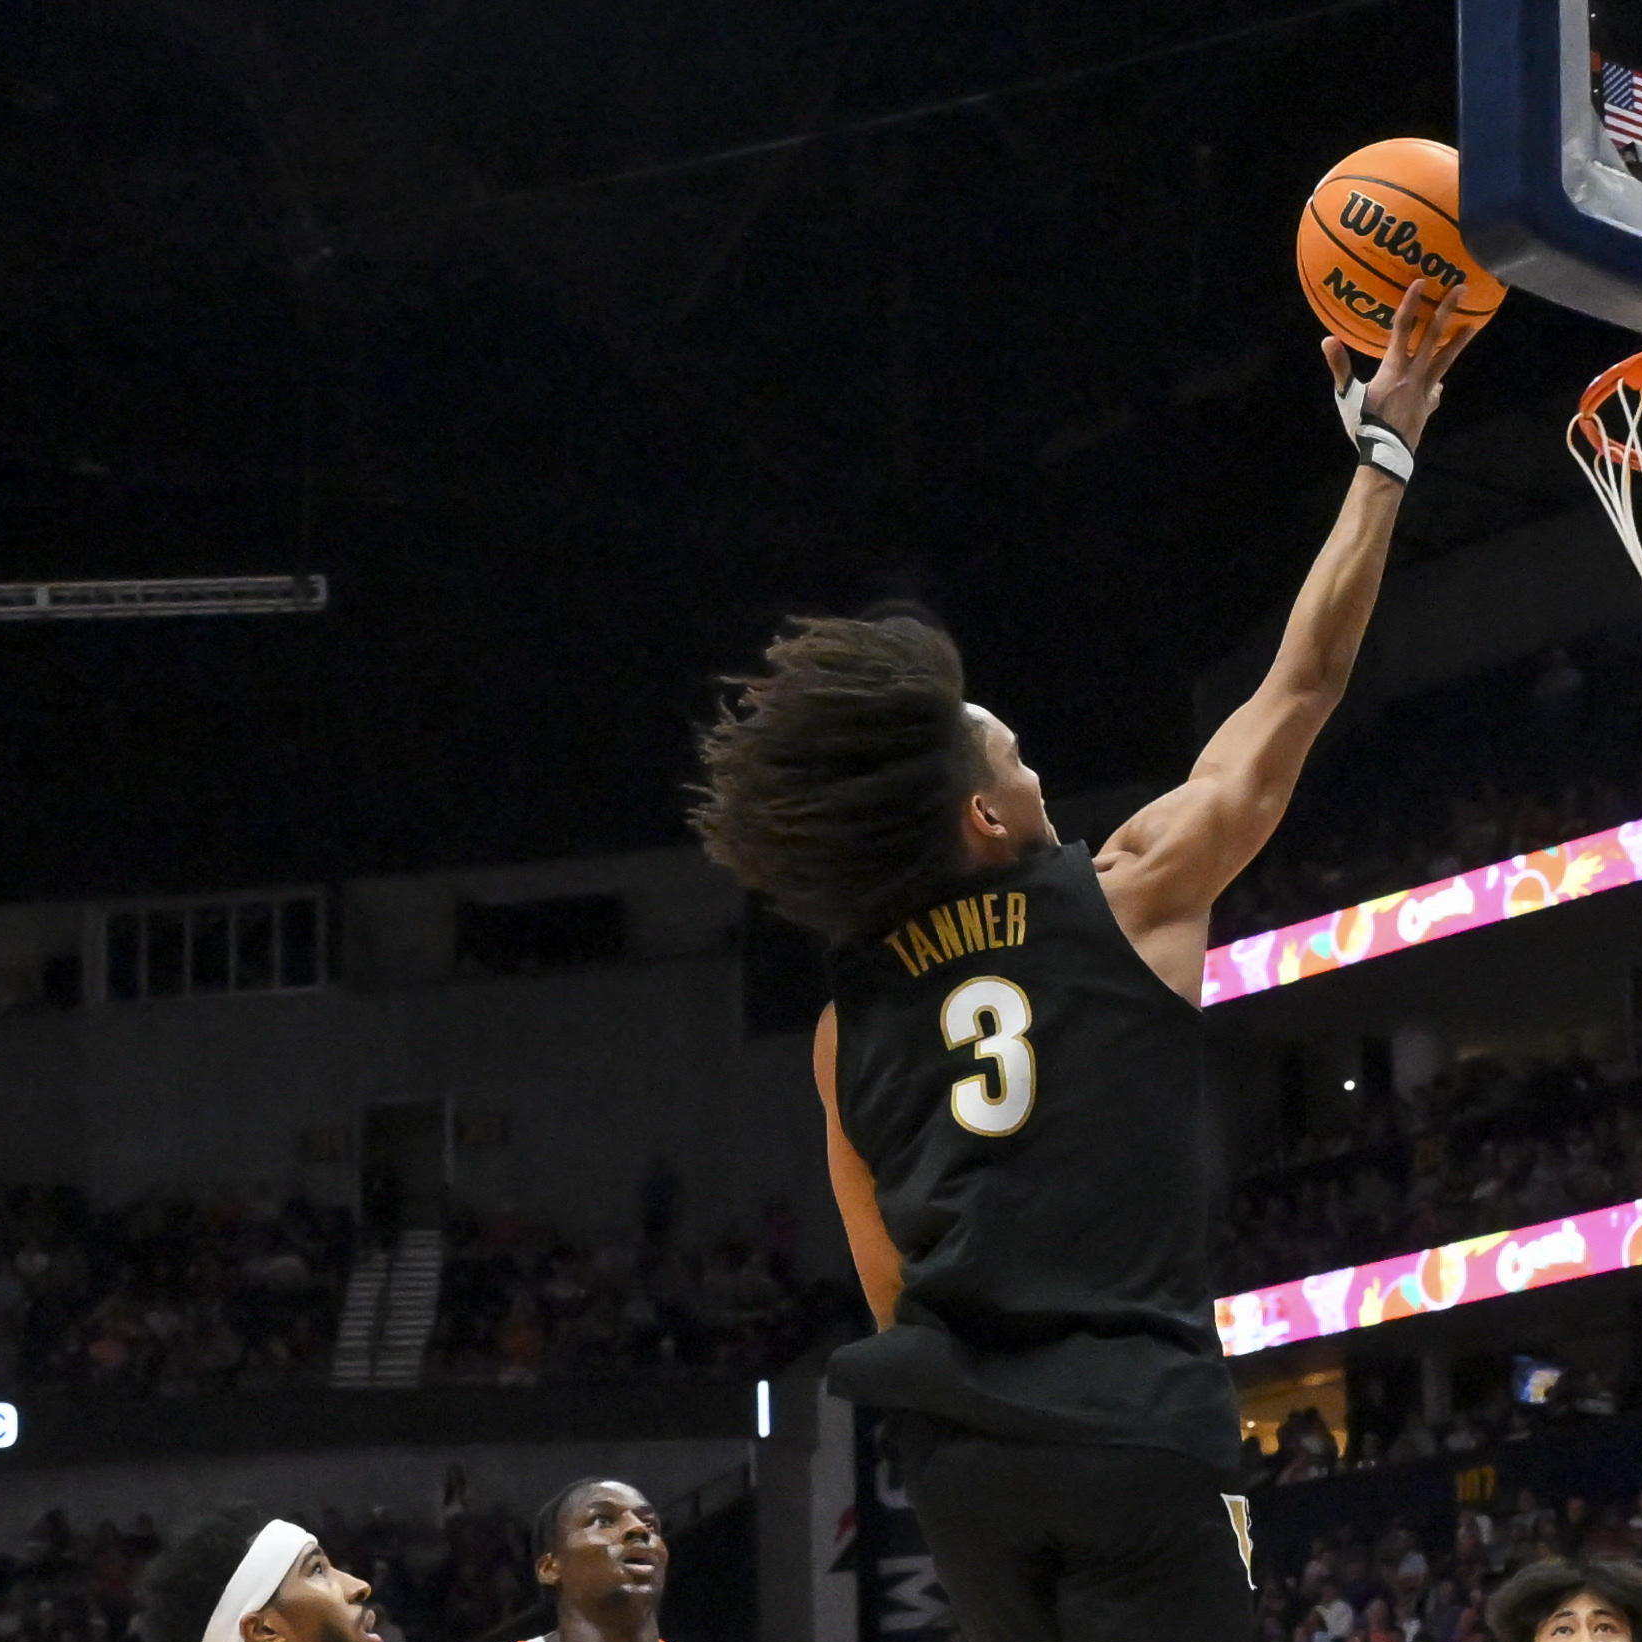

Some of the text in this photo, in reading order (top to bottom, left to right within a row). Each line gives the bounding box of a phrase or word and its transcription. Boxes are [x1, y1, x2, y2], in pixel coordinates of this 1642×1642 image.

[1339, 190, 1467, 287] Wilson
[1323, 266, 1415, 331] NCA
[884, 892, 1027, 977] TANNER
[940, 975, 1037, 1137] 3
